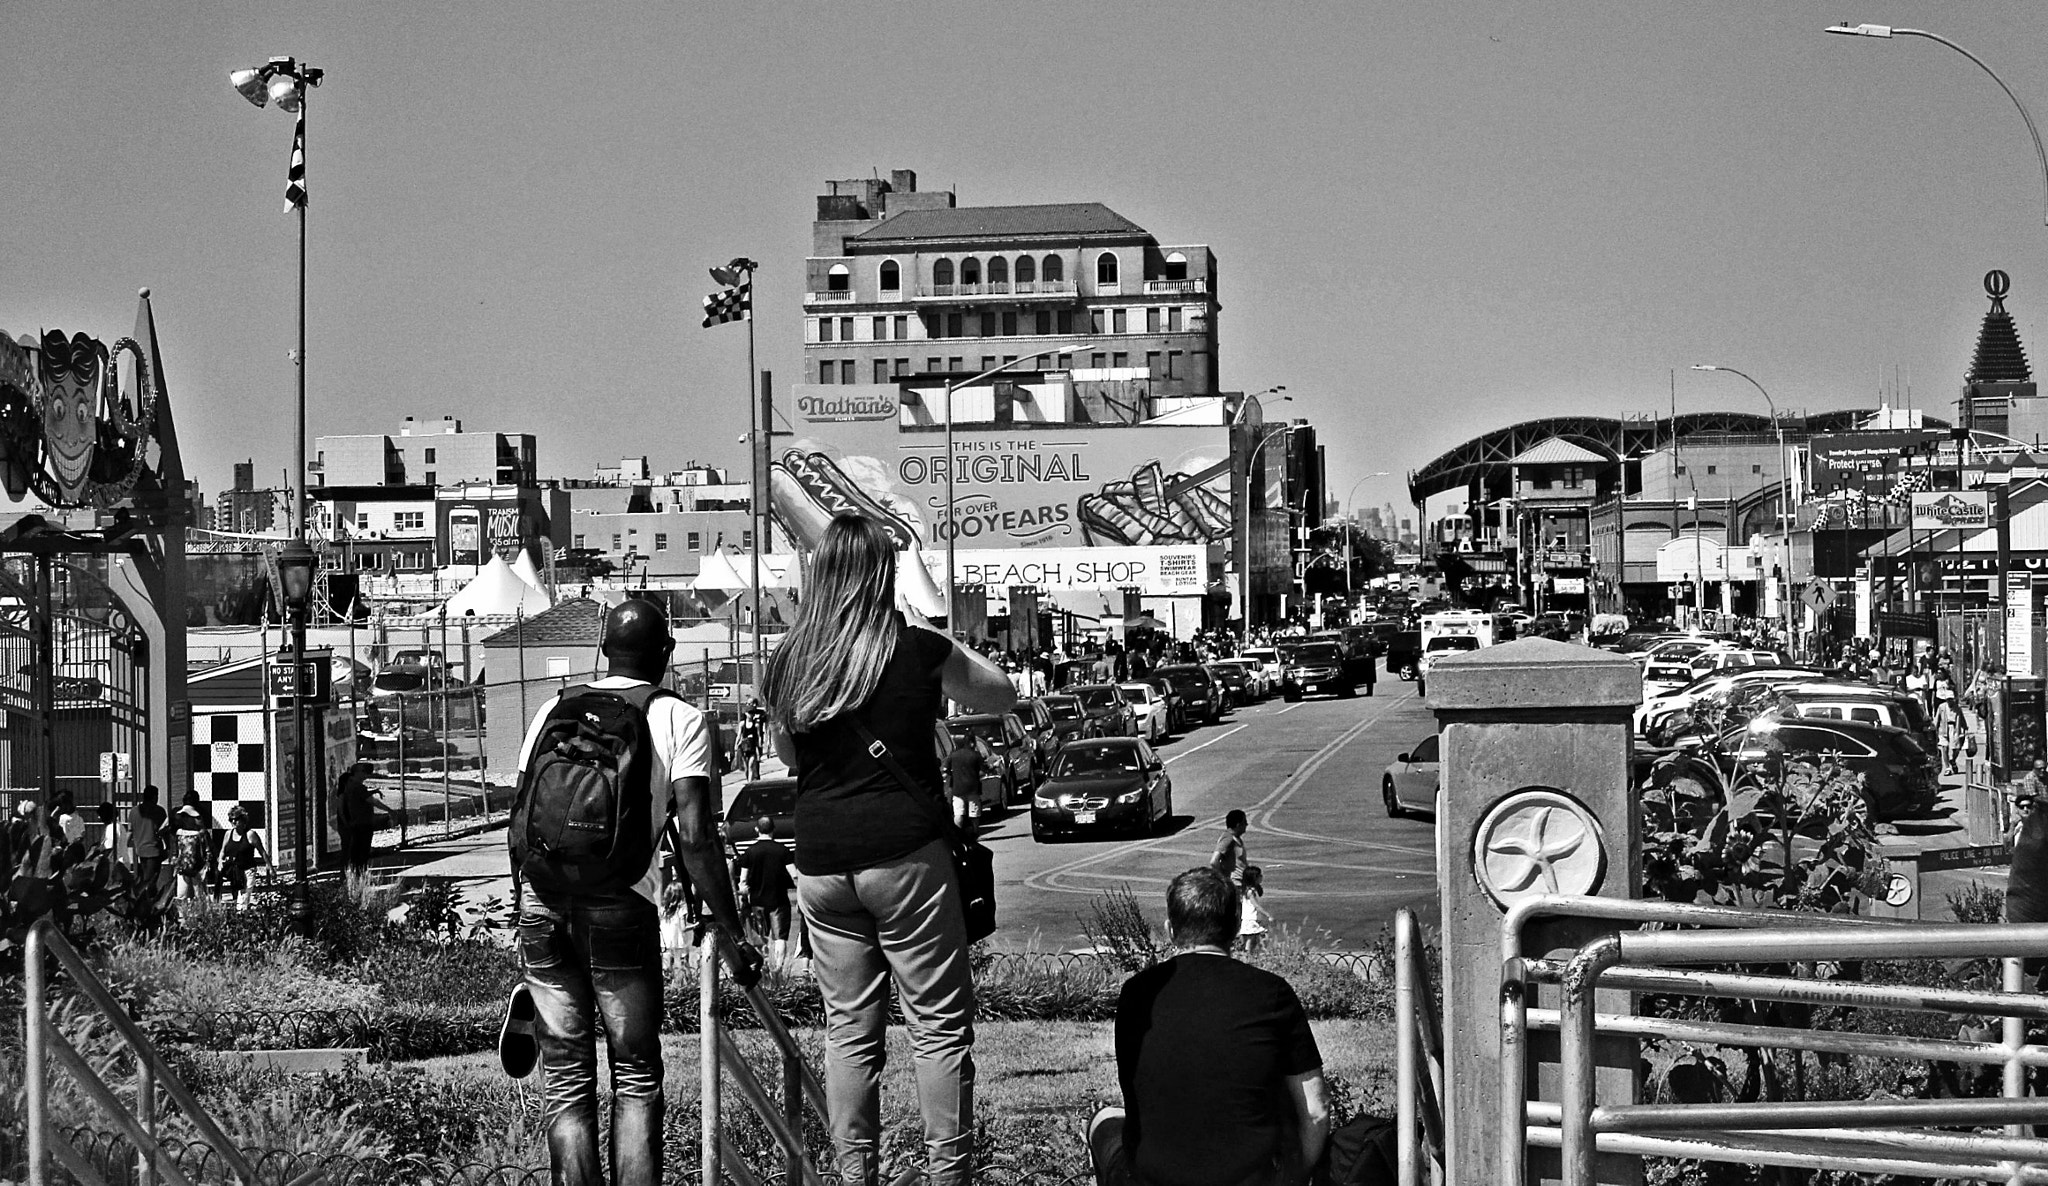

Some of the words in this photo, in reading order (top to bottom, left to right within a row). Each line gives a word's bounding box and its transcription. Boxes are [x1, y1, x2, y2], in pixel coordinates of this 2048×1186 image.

[798, 395, 897, 416] Nathan's
[953, 441, 986, 451] THIS
[990, 441, 1002, 451] IS
[1007, 440, 1036, 450] THE
[900, 453, 1090, 485] ORIGINAL
[1829, 459, 1855, 470] Protect
[965, 502, 998, 515] OVER
[1915, 505, 1948, 517] White
[1948, 504, 1985, 516] Castle
[984, 503, 1069, 532] YEARS
[963, 563, 1061, 585] BEACH
[1076, 561, 1146, 584] SHOP
[272, 667, 281, 675] NO
